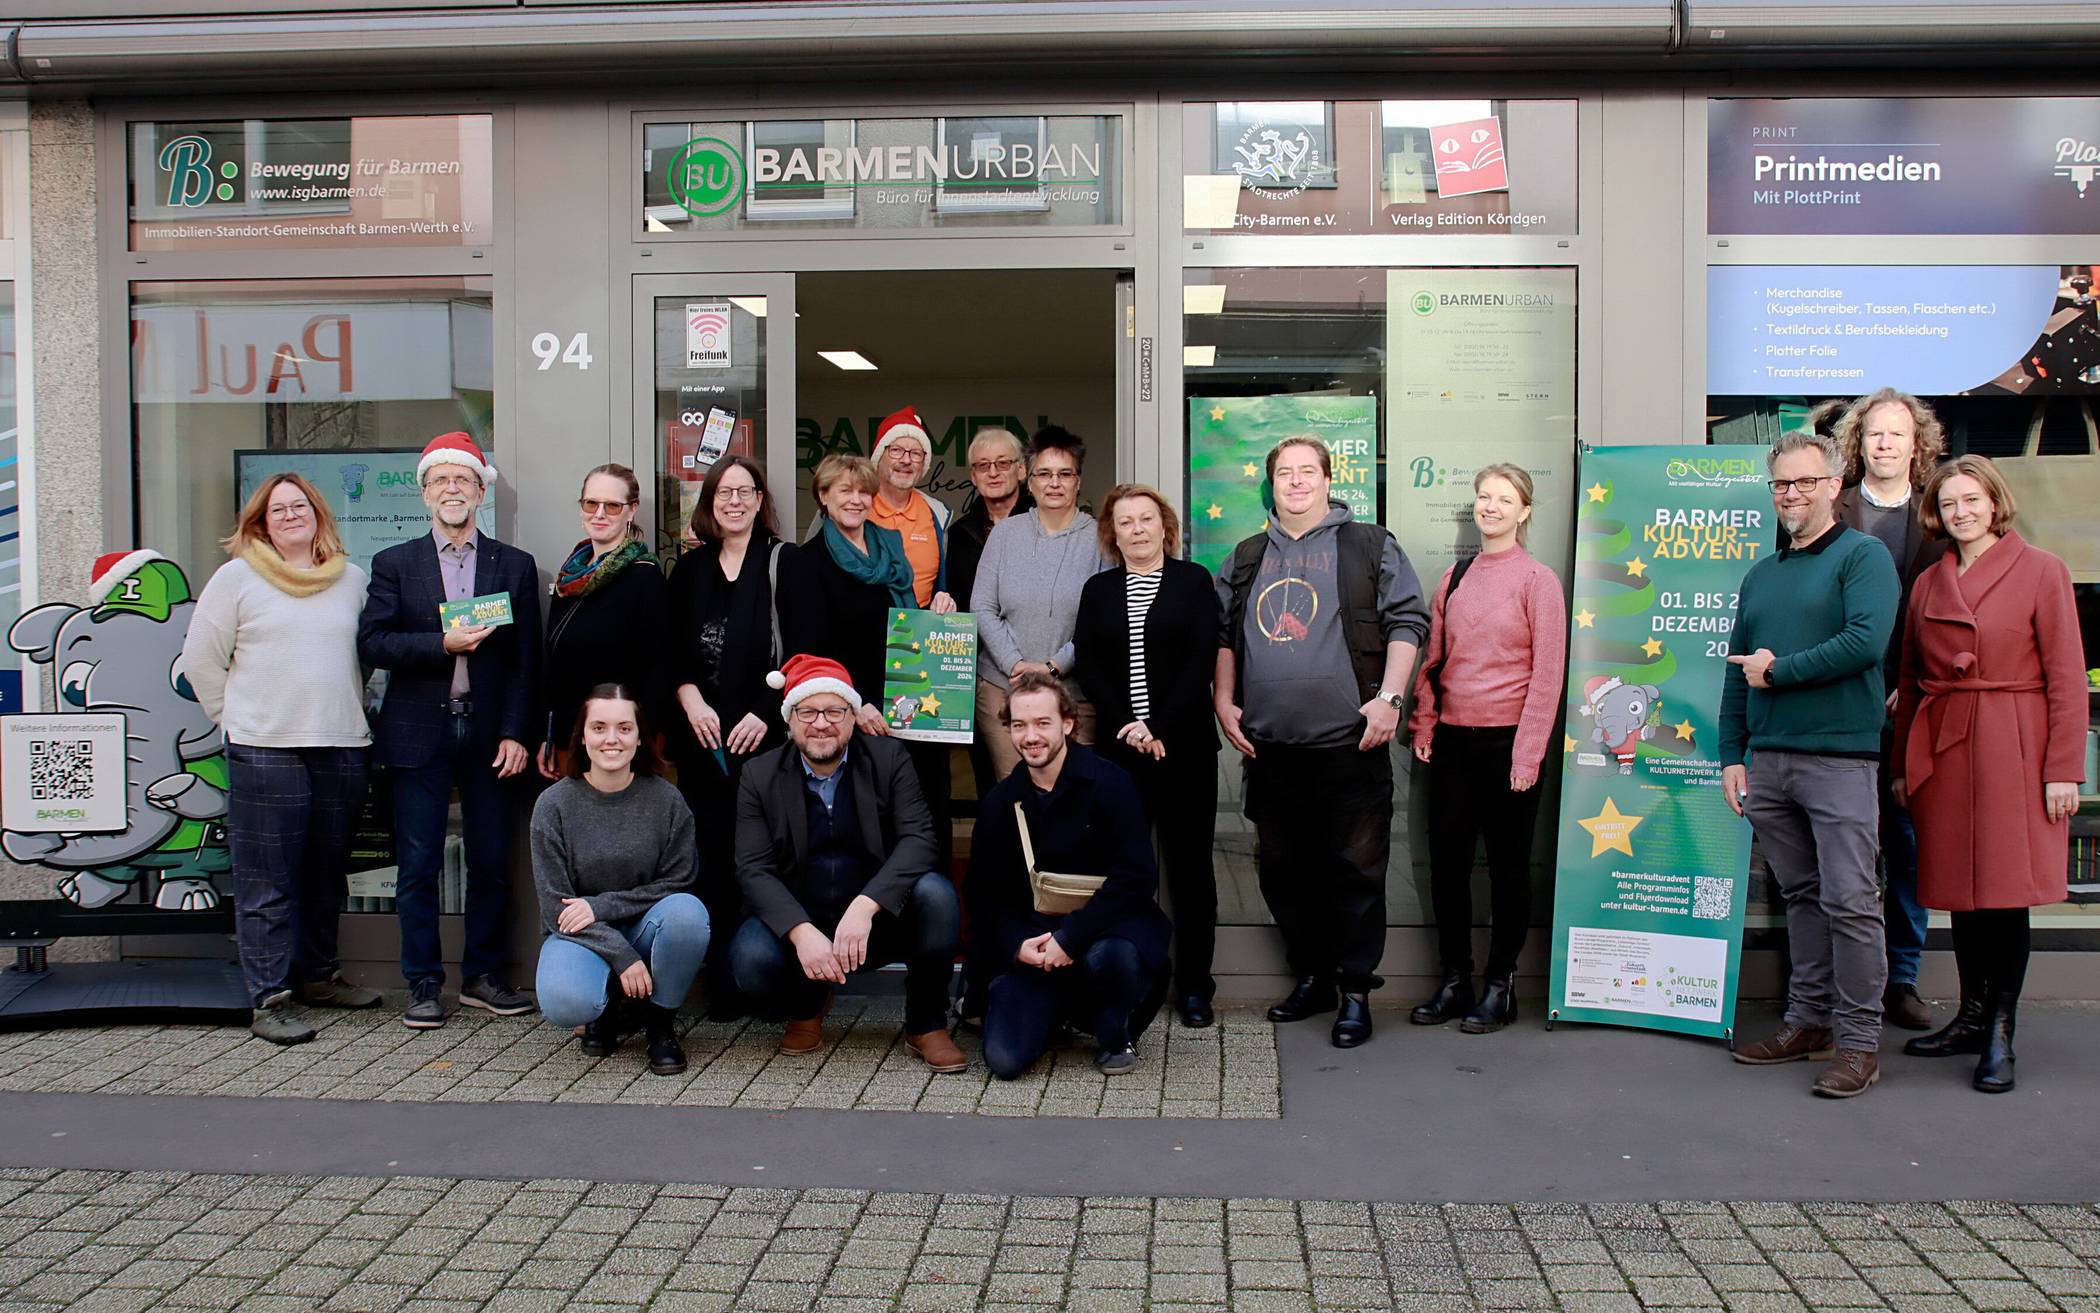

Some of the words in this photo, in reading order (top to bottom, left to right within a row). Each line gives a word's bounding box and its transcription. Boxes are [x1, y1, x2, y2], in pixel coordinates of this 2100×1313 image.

[1752, 127, 1798, 138] PRINT
[250, 161, 351, 181] Bewegung
[356, 159, 385, 176] für
[388, 158, 460, 175] Barmen
[755, 143, 1100, 183] BARMENURBAN
[1753, 155, 1941, 182] Printmedien
[250, 185, 386, 202] www.isgbarmen.de
[876, 189, 910, 204] Büro
[914, 189, 933, 203] für
[1753, 190, 1780, 204] Mit
[1784, 190, 1861, 204] PlottPrint
[1313, 214, 1337, 226] e.V.
[1391, 213, 1433, 228] Verlag
[1437, 213, 1483, 226] Edition
[1487, 212, 1546, 227] Köndgen
[144, 224, 357, 239] Immobilien-Standort-Gemeinschaft
[359, 221, 449, 235] Barmen-Werth
[452, 222, 475, 233] e.V.
[1440, 294, 1553, 306] BARMENURBAN
[1766, 287, 1843, 299] Merchandise
[1766, 303, 1862, 316] (Kugelschreiber,
[1864, 303, 1911, 316] Tassen,
[1913, 302, 1966, 315] Flaschen
[1968, 303, 1996, 316] etc.)
[1766, 324, 1831, 336] Textildruck
[1834, 325, 1843, 336] &
[1846, 323, 1949, 337] Berufsbekleidung
[531, 332, 593, 371] 94
[690, 350, 728, 361] Freifunk
[1766, 345, 1806, 357] Plotter
[1809, 345, 1838, 357] Folie
[1766, 365, 1864, 379] Transferpressen
[681, 385, 693, 393] Mit
[711, 384, 725, 393] App
[1324, 439, 1369, 456] MER
[378, 471, 417, 487] BAR
[1330, 468, 1369, 484] ENT
[1351, 490, 1369, 500] 24.
[334, 514, 388, 522] tandortmarke
[1655, 508, 1761, 528] BARMER
[1643, 524, 1748, 543] KULTUR-
[1653, 541, 1761, 560] ADVENT
[1660, 592, 1687, 608] 01.
[1693, 592, 1723, 609] BIS
[1728, 593, 1740, 609] 2
[1652, 616, 1736, 633] DEZEMB
[929, 631, 974, 642] BARMER
[928, 646, 974, 656] ADVENT
[1705, 641, 1729, 657] 20
[10, 724, 47, 733] Weitere
[49, 723, 118, 733] Informationen
[1661, 758, 1721, 767] Gemeinschaftsakt
[1649, 767, 1715, 776] KULTURNETZWERK
[1616, 881, 1632, 889] Alle
[1633, 882, 1690, 894] Programminfos
[1619, 892, 1634, 900] und
[1635, 892, 1689, 904] Flyerdownload
[1623, 902, 1689, 915] kultur-barmen.de
[1677, 975, 1718, 989] KULTUR
[1676, 994, 1717, 1008] BARMEN
